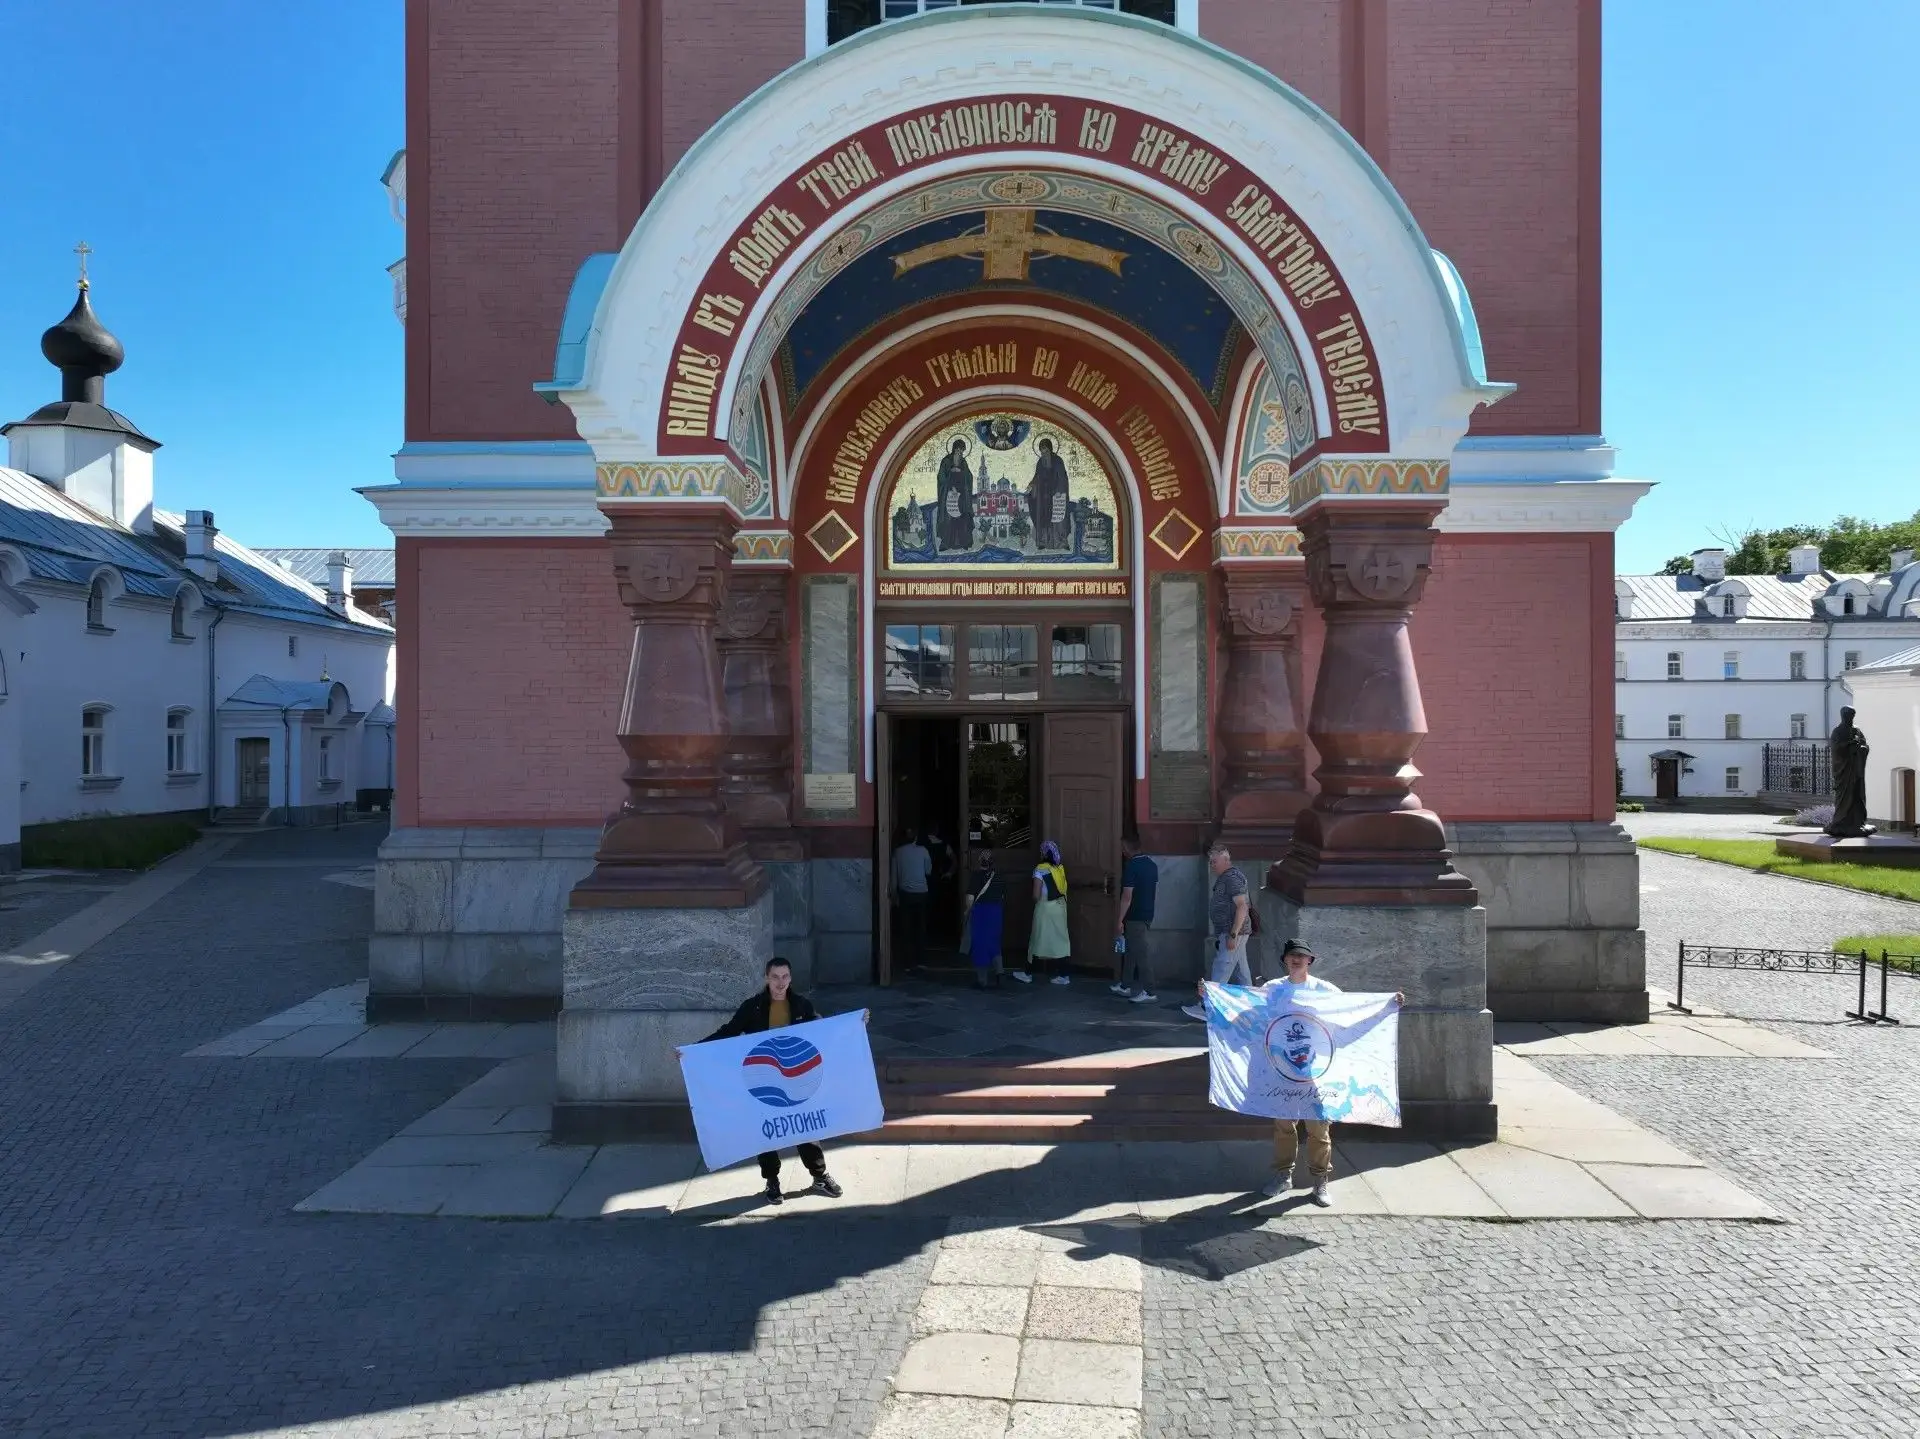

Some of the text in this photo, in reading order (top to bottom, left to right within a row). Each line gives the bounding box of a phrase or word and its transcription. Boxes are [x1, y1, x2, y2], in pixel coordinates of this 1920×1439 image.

[1078, 107, 1117, 153] КО
[1131, 123, 1230, 195] ХРАМУ
[729, 203, 806, 289] ДОМЪ
[693, 293, 744, 337] ВЪ
[1031, 346, 1060, 379] ВО
[666, 344, 721, 436] ВНИДУ
[761, 1109, 828, 1140] ФЕРТОИНГ
